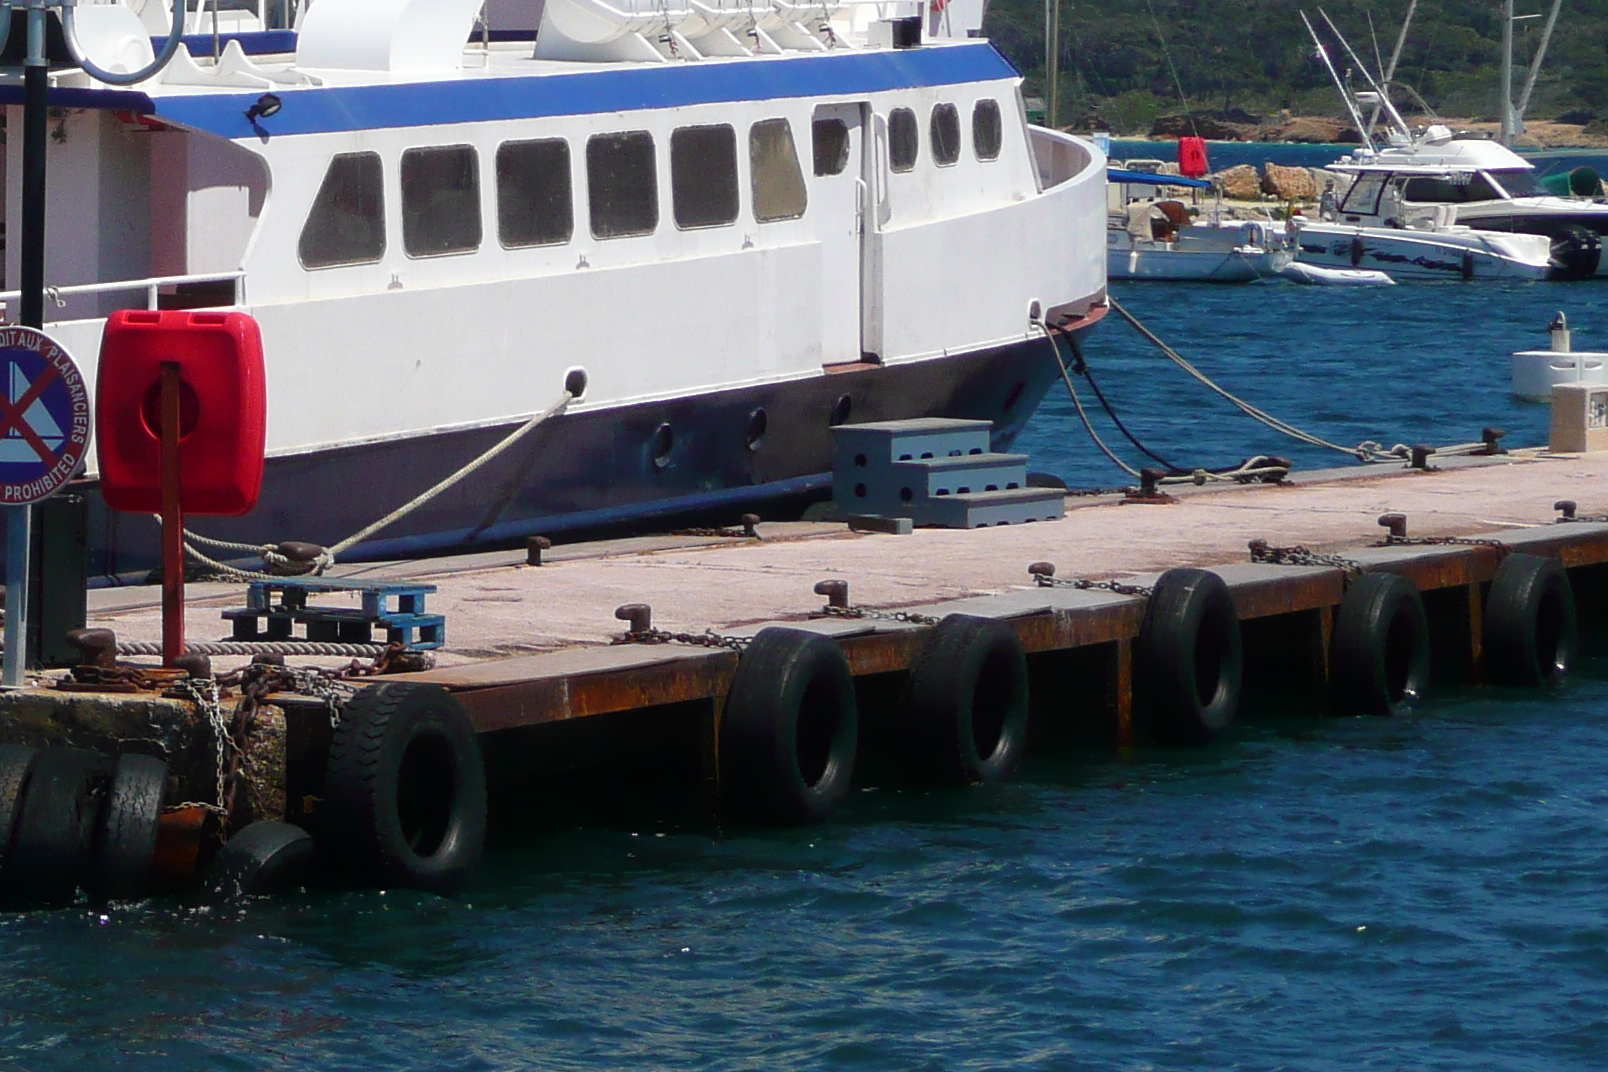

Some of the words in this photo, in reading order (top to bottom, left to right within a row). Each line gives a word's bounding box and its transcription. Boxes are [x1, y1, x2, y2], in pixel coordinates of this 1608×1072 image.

[17, 332, 42, 351] AUX
[46, 347, 89, 445] PLAISANCIERS
[4, 452, 75, 501] PROHIBITED
